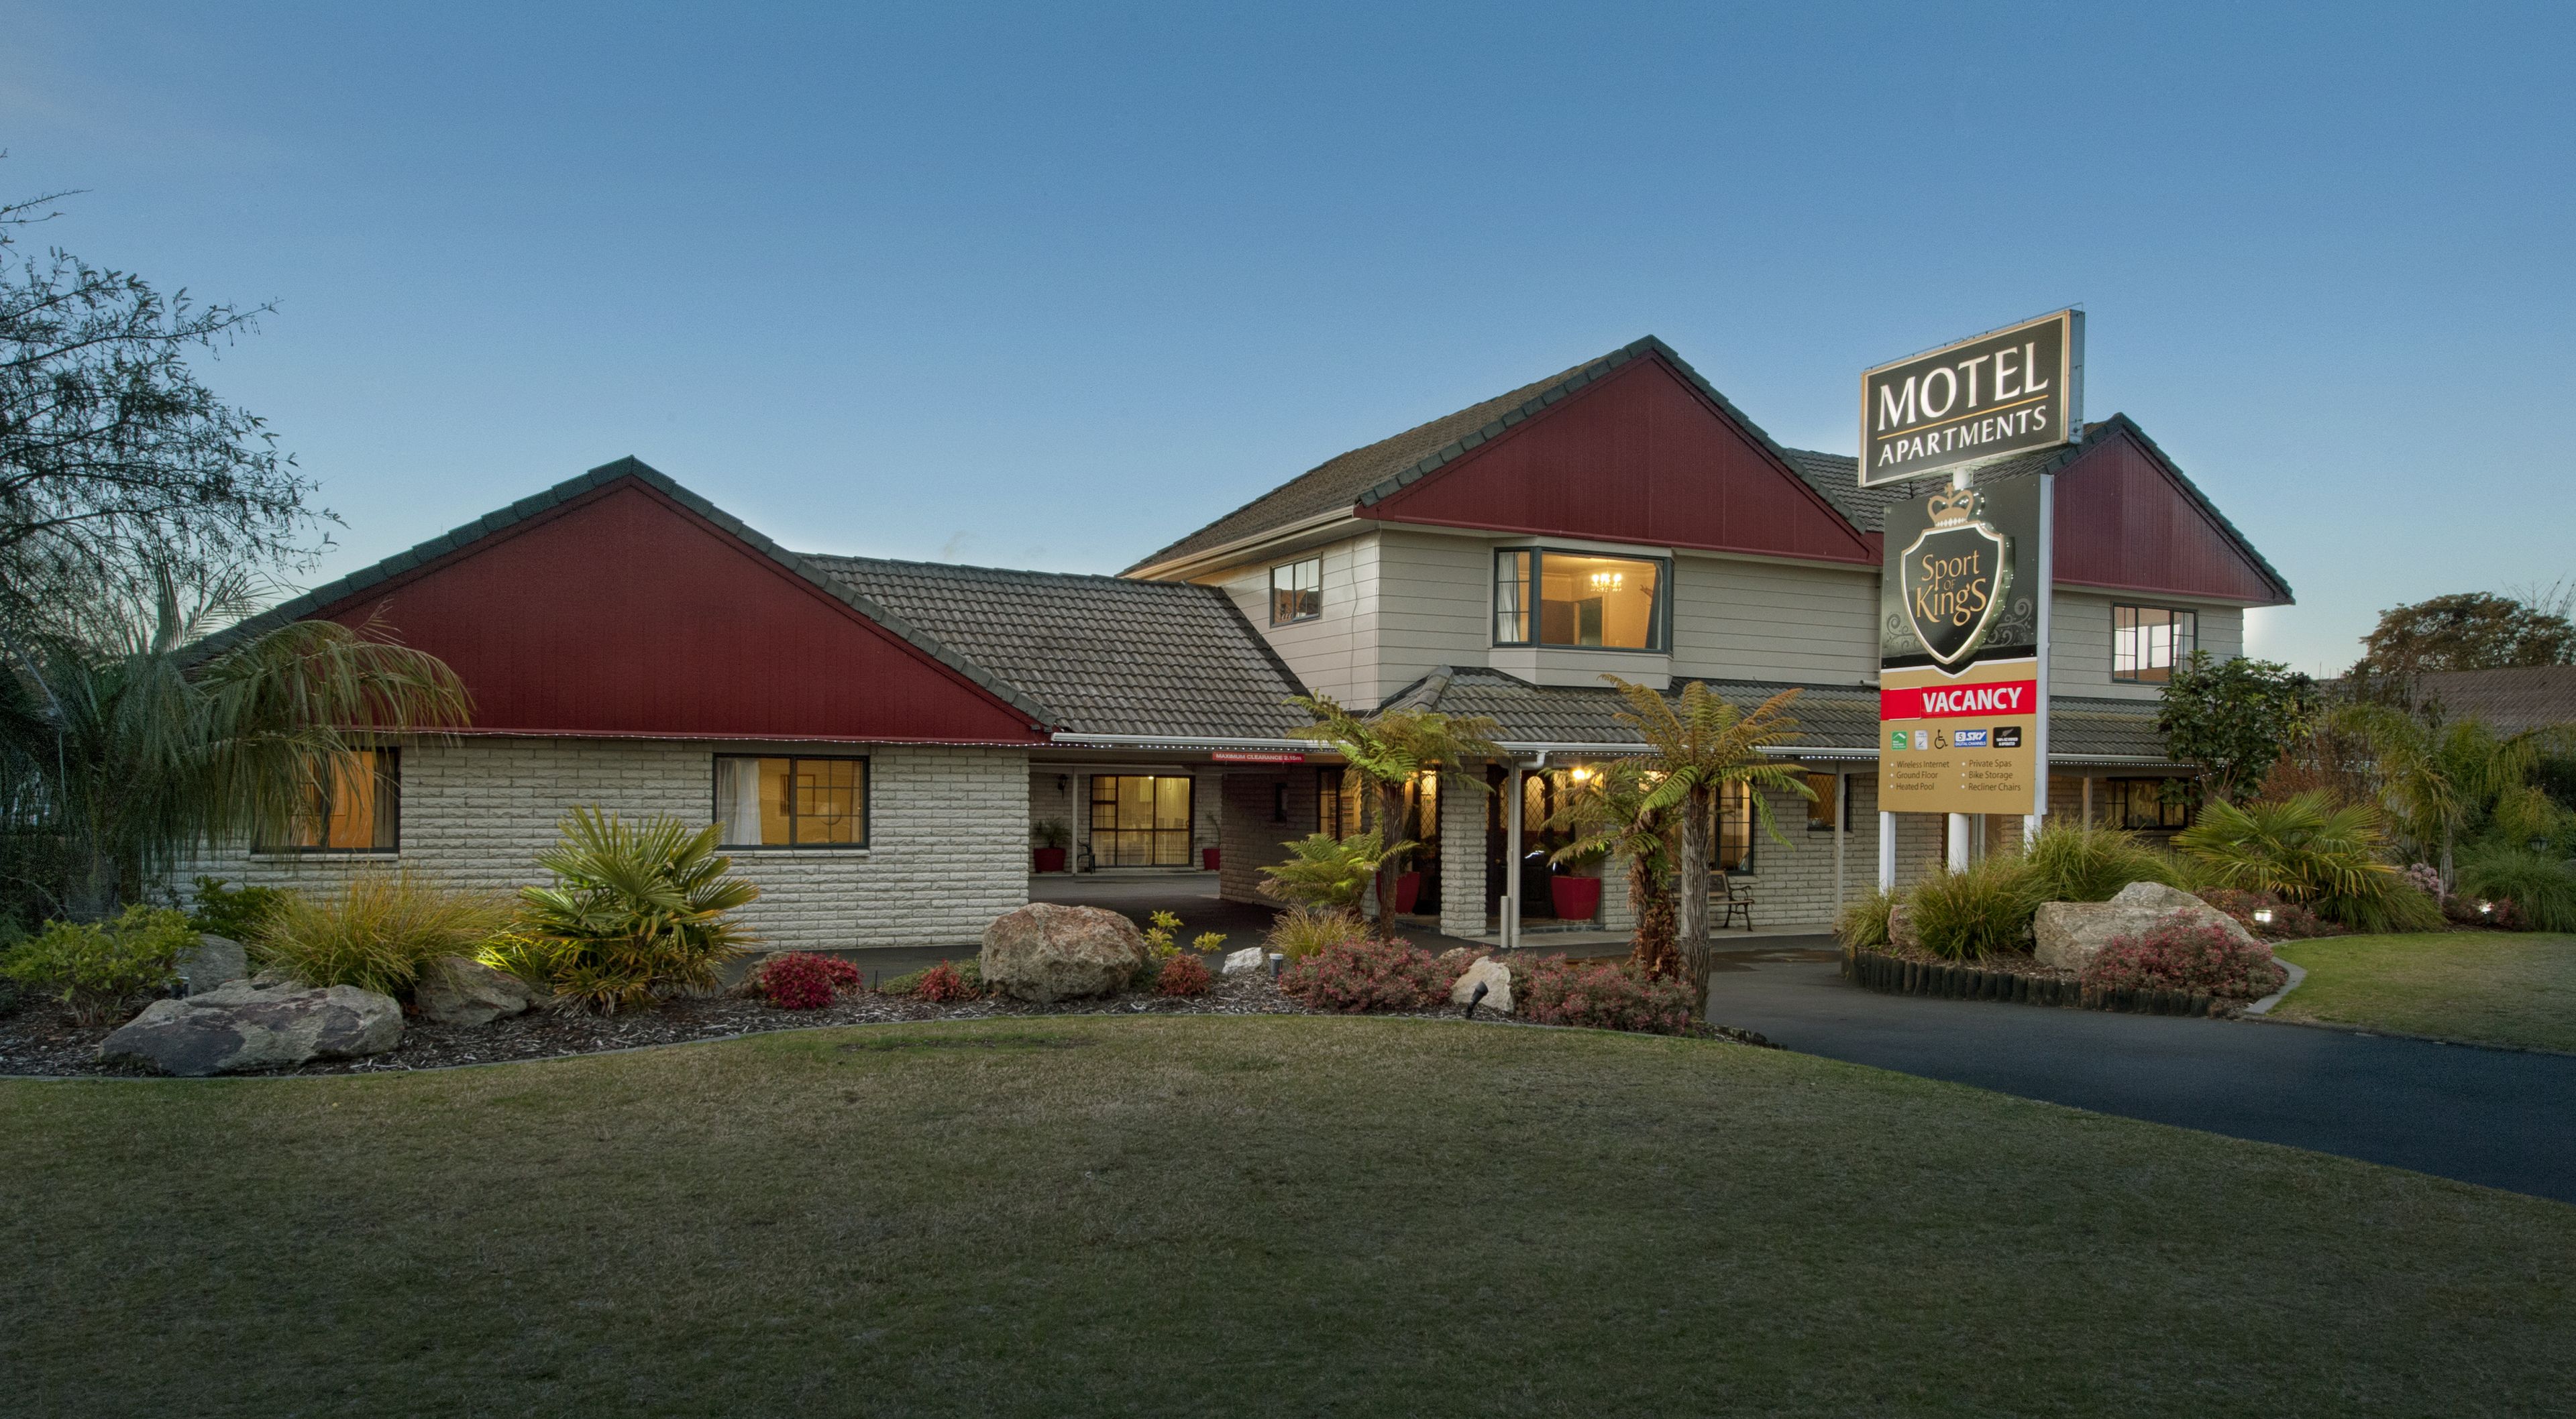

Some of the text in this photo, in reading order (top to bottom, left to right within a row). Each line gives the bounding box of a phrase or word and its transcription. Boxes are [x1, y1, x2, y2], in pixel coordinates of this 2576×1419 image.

[1877, 342, 2049, 431] MOTEL
[1878, 404, 2047, 467] APARTMENTS
[1921, 550, 1980, 591] Sport
[1922, 687, 2023, 713] VACANCY
[1966, 732, 1986, 741] SKY
[1896, 760, 1922, 769] Wireless
[1969, 759, 2012, 769] Private Spas
[1896, 771, 1938, 779] Ground Floor
[1969, 771, 2013, 781] Bike Storage
[1968, 783, 2021, 791] Recliner Chairs
